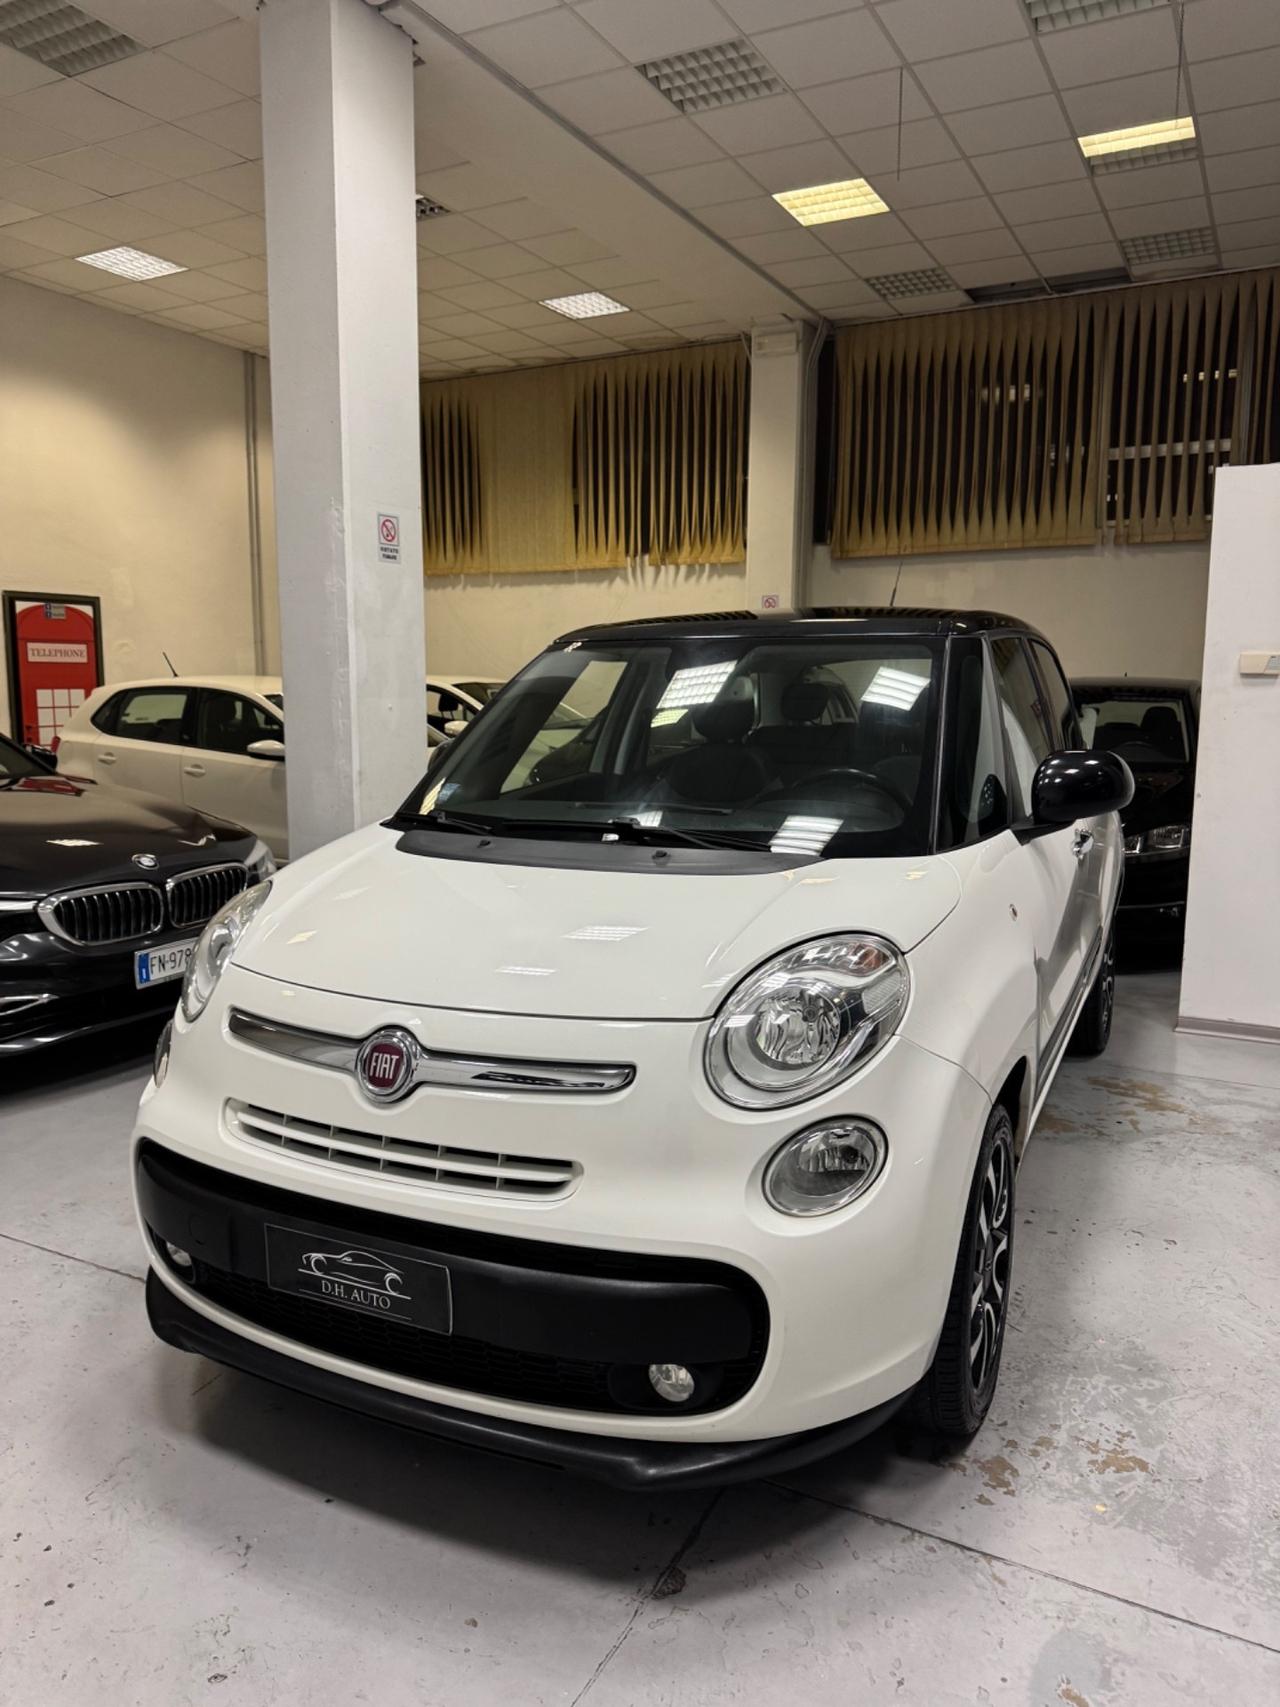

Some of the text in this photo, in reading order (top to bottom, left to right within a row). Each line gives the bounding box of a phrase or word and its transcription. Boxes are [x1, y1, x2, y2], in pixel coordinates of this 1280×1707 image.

[30, 647, 86, 658] TELEPHONE
[369, 1052, 400, 1080] FIAT
[321, 1279, 391, 1310] D.H. AUTO
